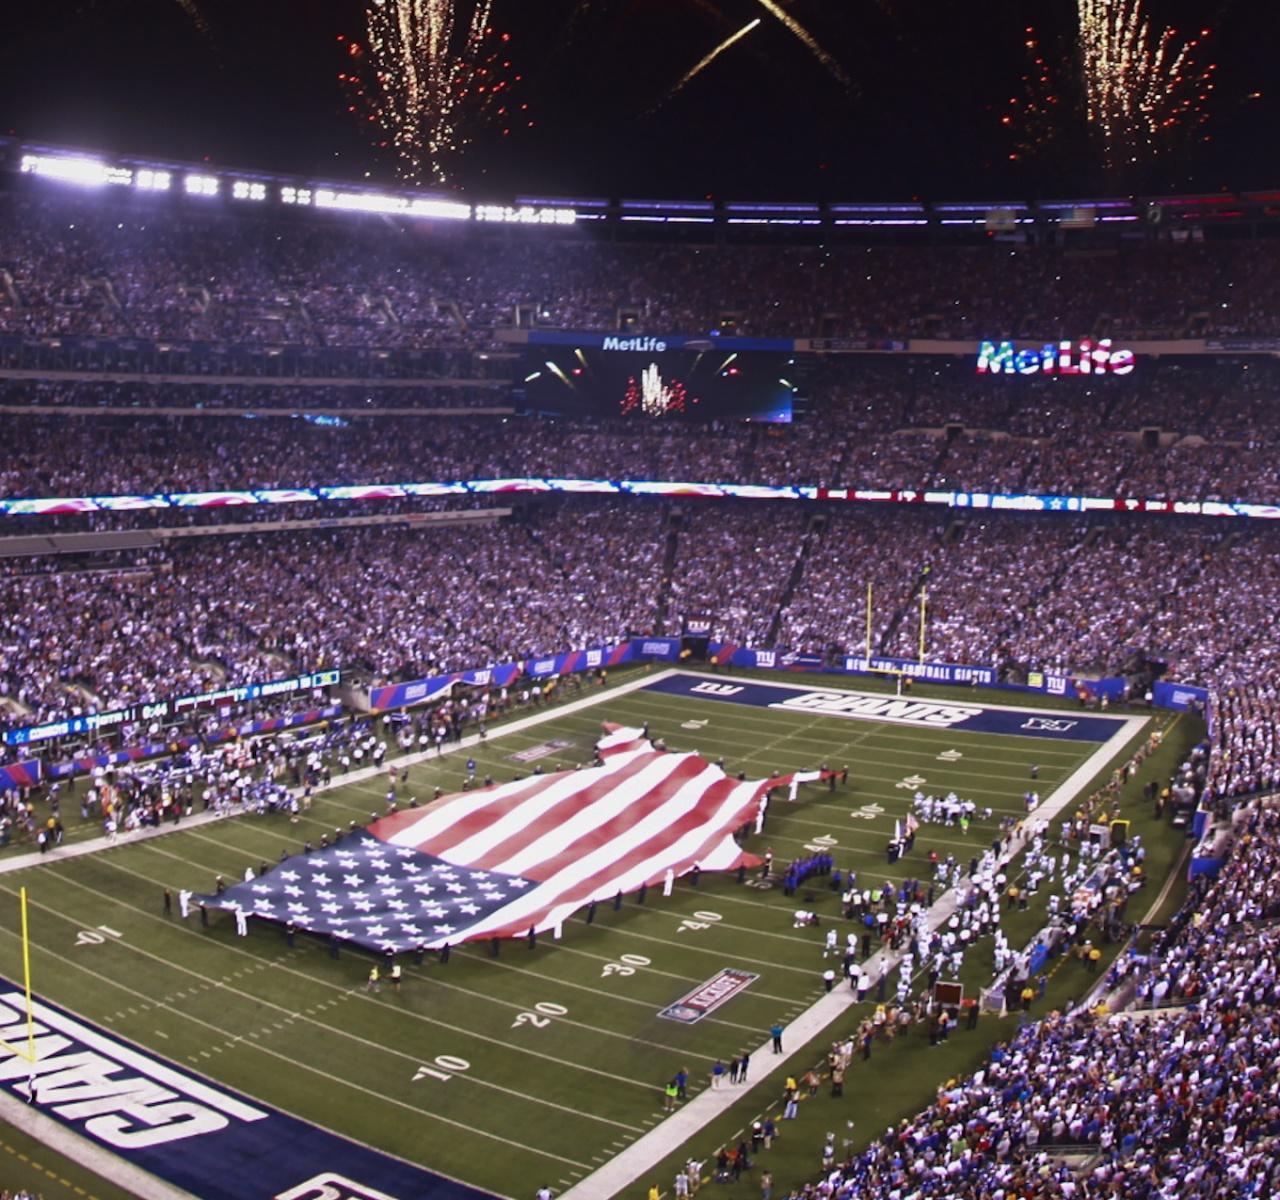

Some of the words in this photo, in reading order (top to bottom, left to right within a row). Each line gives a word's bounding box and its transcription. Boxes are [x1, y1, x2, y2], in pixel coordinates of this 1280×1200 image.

[603, 337, 667, 352] MetLife
[975, 339, 1136, 376] MetLife
[846, 658, 869, 672] NEW
[902, 663, 951, 680] FOOTBALL
[778, 690, 985, 725] GIANTS
[682, 911, 723, 932] 40
[608, 954, 652, 977] 30
[517, 1002, 569, 1028] 20
[418, 1055, 471, 1082] 10
